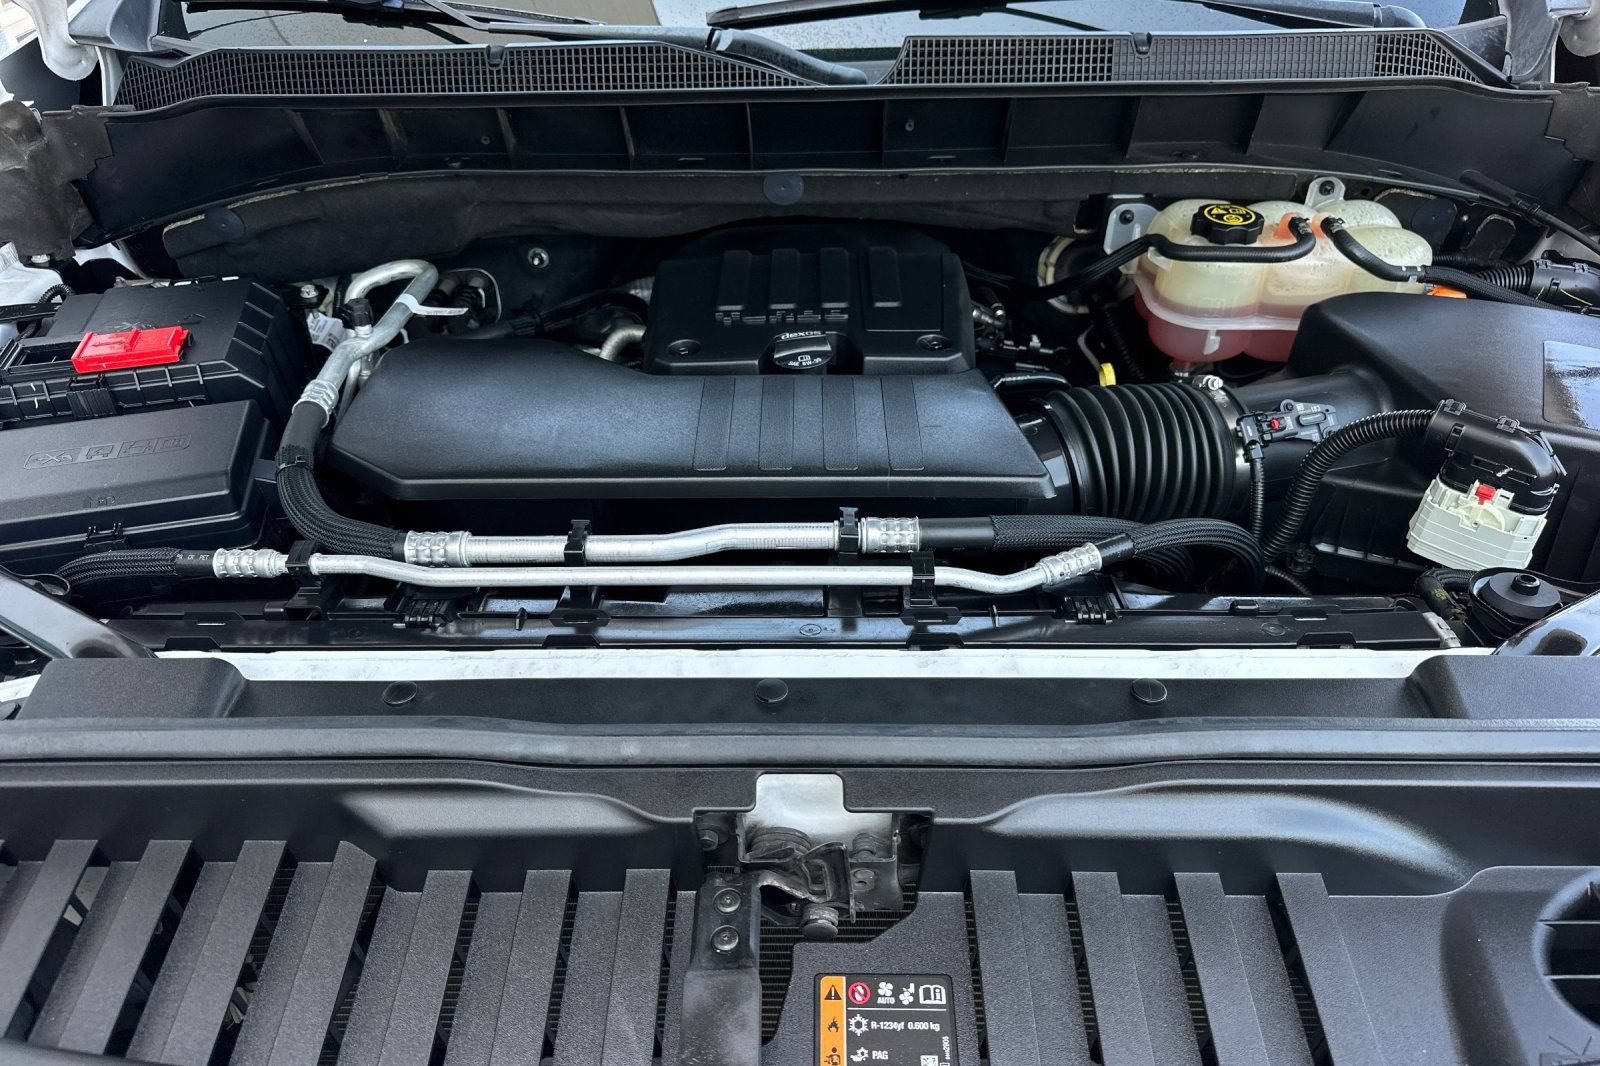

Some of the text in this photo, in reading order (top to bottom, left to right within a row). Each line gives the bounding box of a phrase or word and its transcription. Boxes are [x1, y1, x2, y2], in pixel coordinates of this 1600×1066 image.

[781, 331, 821, 340] dexos
[877, 996, 895, 1005] AUTO
[870, 1021, 940, 1032] R-1234yf 0.600 kg
[872, 1051, 889, 1060] PAG
